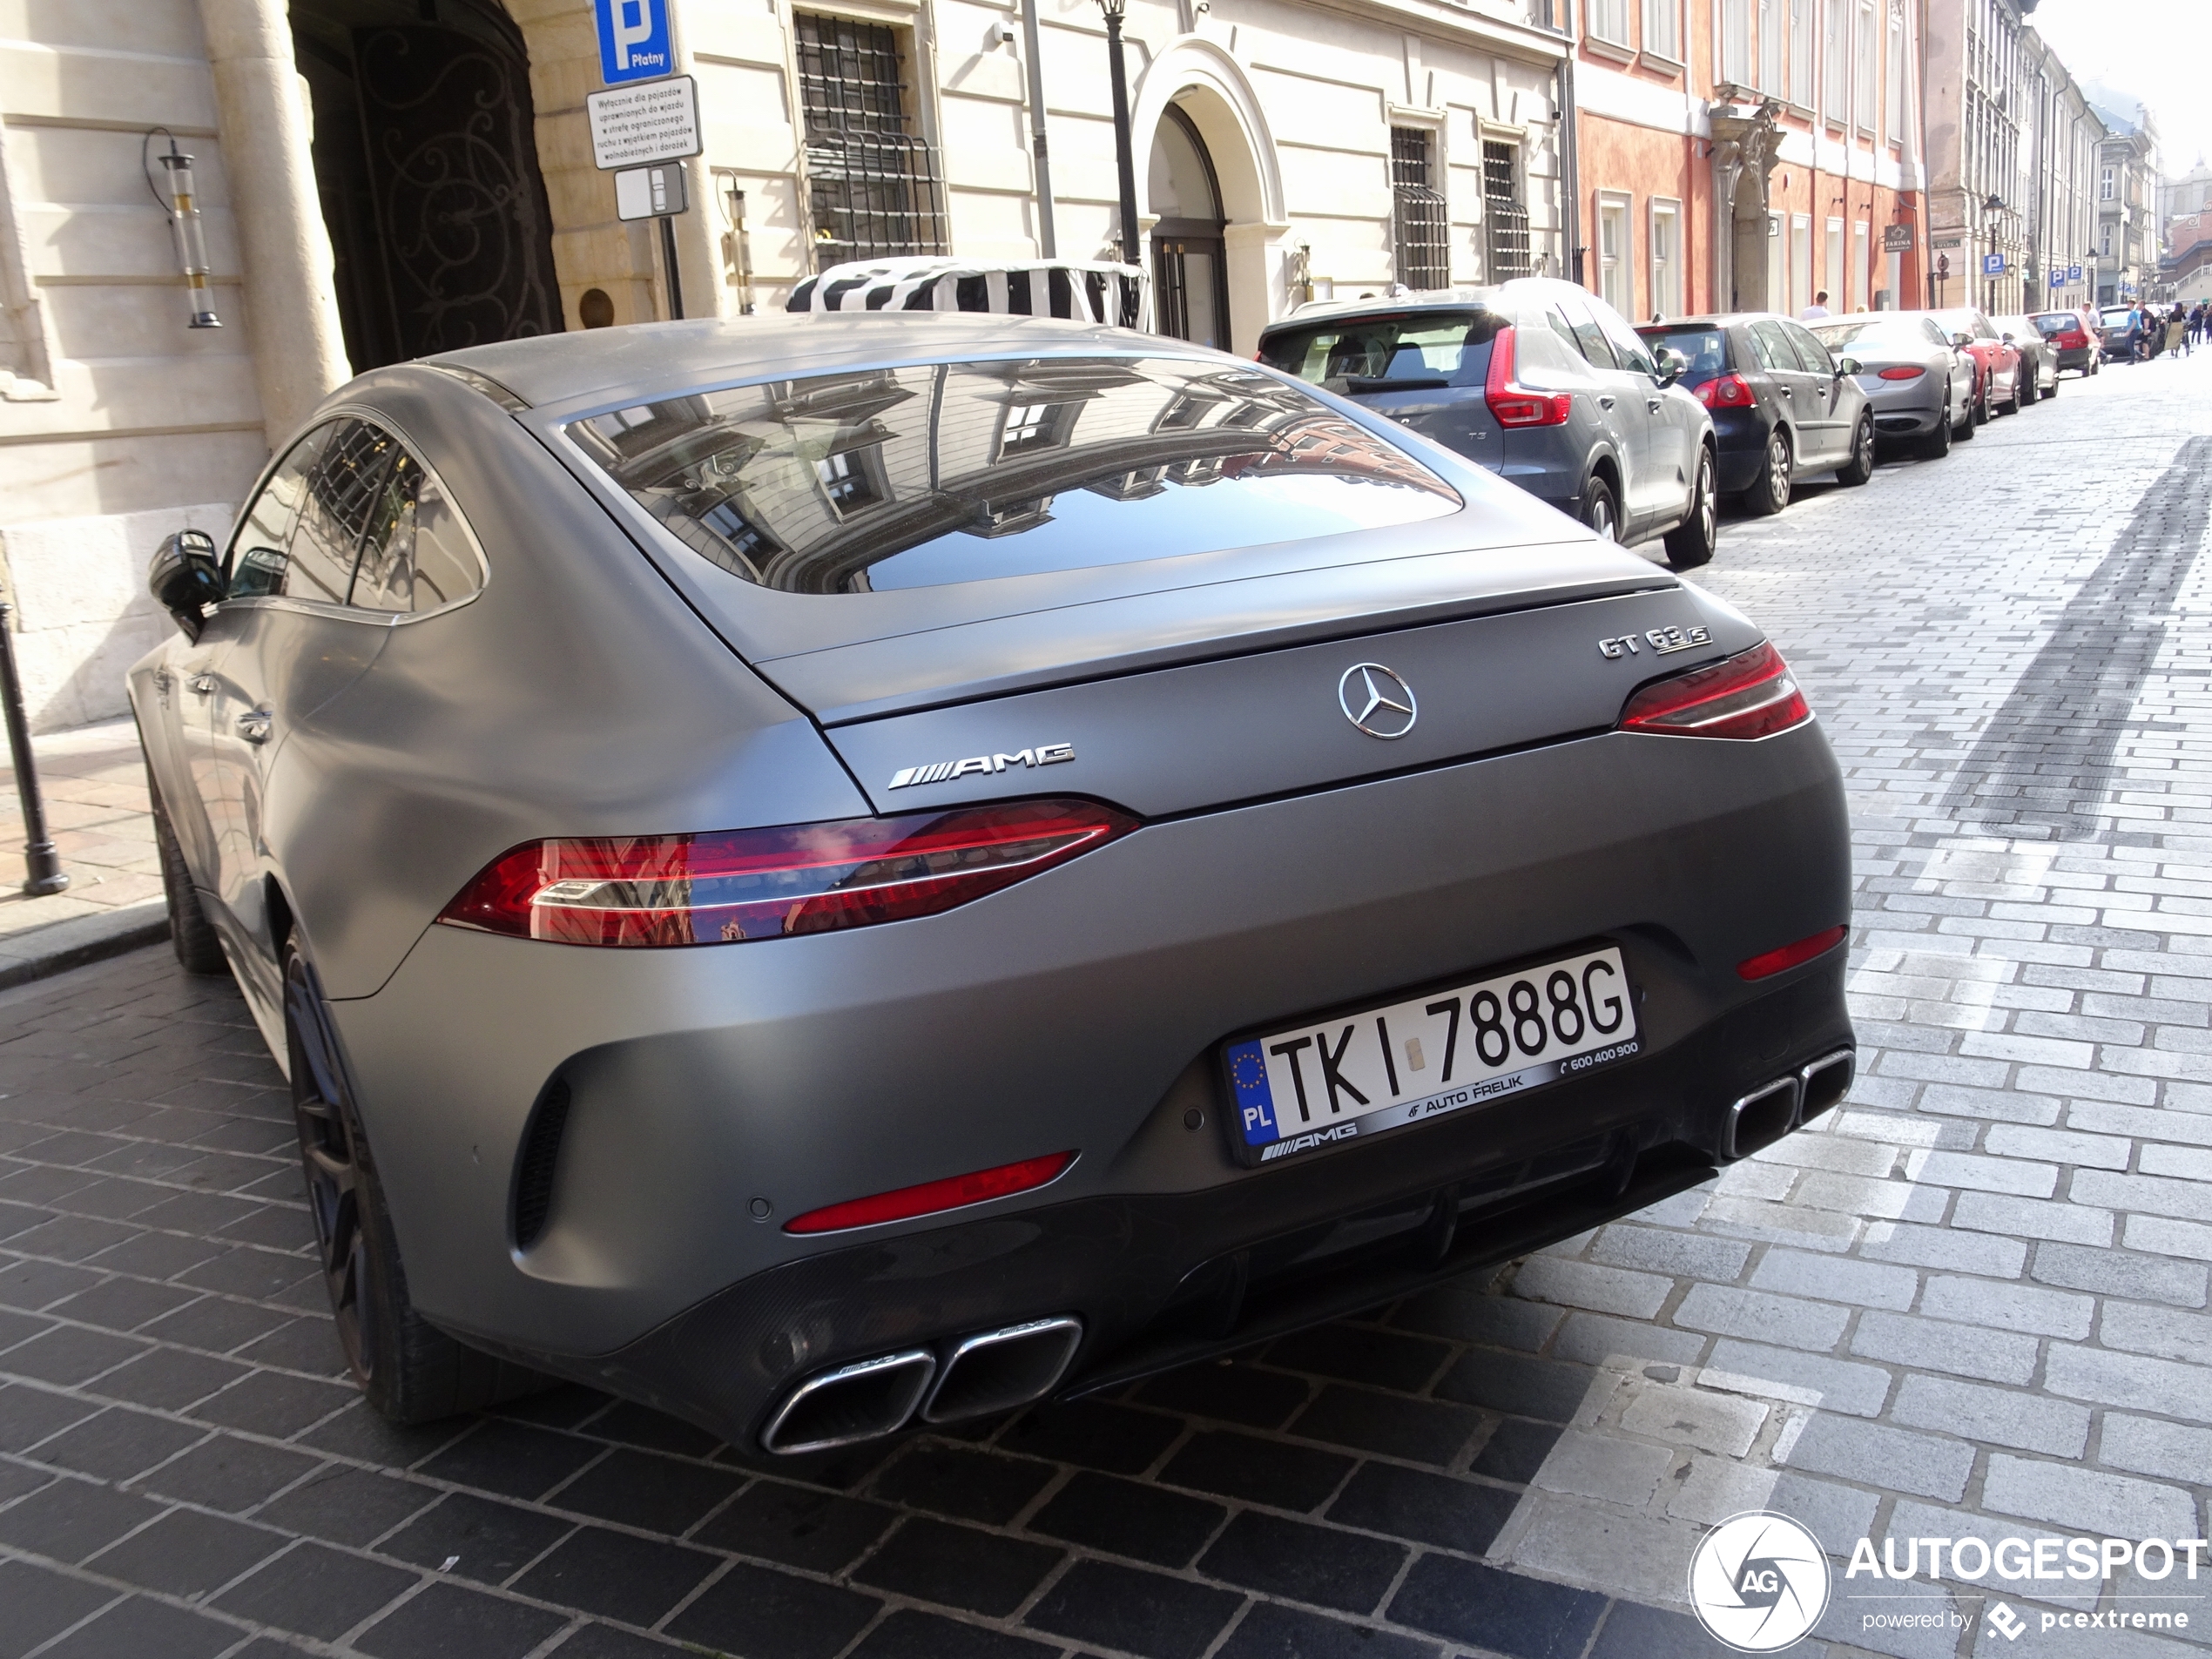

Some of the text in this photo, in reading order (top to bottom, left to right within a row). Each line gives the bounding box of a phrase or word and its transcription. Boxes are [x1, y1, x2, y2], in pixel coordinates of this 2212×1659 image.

[610, 0, 652, 71] P
[631, 52, 664, 67] Płatny
[597, 87, 682, 111] Wyłącznie dla pojazdów
[599, 100, 685, 124] uprawnionych do wjazdu
[609, 123, 629, 134] strefę
[631, 114, 685, 132] ograniczonego
[597, 138, 617, 149] ruchu
[624, 132, 658, 146] wyjątkiem
[659, 125, 693, 140] pojazdów
[604, 145, 654, 160] wolnobieżnych
[659, 139, 689, 152] dorożek
[1598, 634, 1640, 659] GT
[948, 743, 1076, 779] AMG
[1269, 960, 1623, 1123] TKI 7888G
[1570, 1042, 1638, 1070] 600 400 900
[1426, 1091, 1468, 1113] AUTO
[1473, 1076, 1523, 1099] FRELIK
[1244, 1105, 1272, 1131] PL
[1292, 1123, 1358, 1153] AMG
